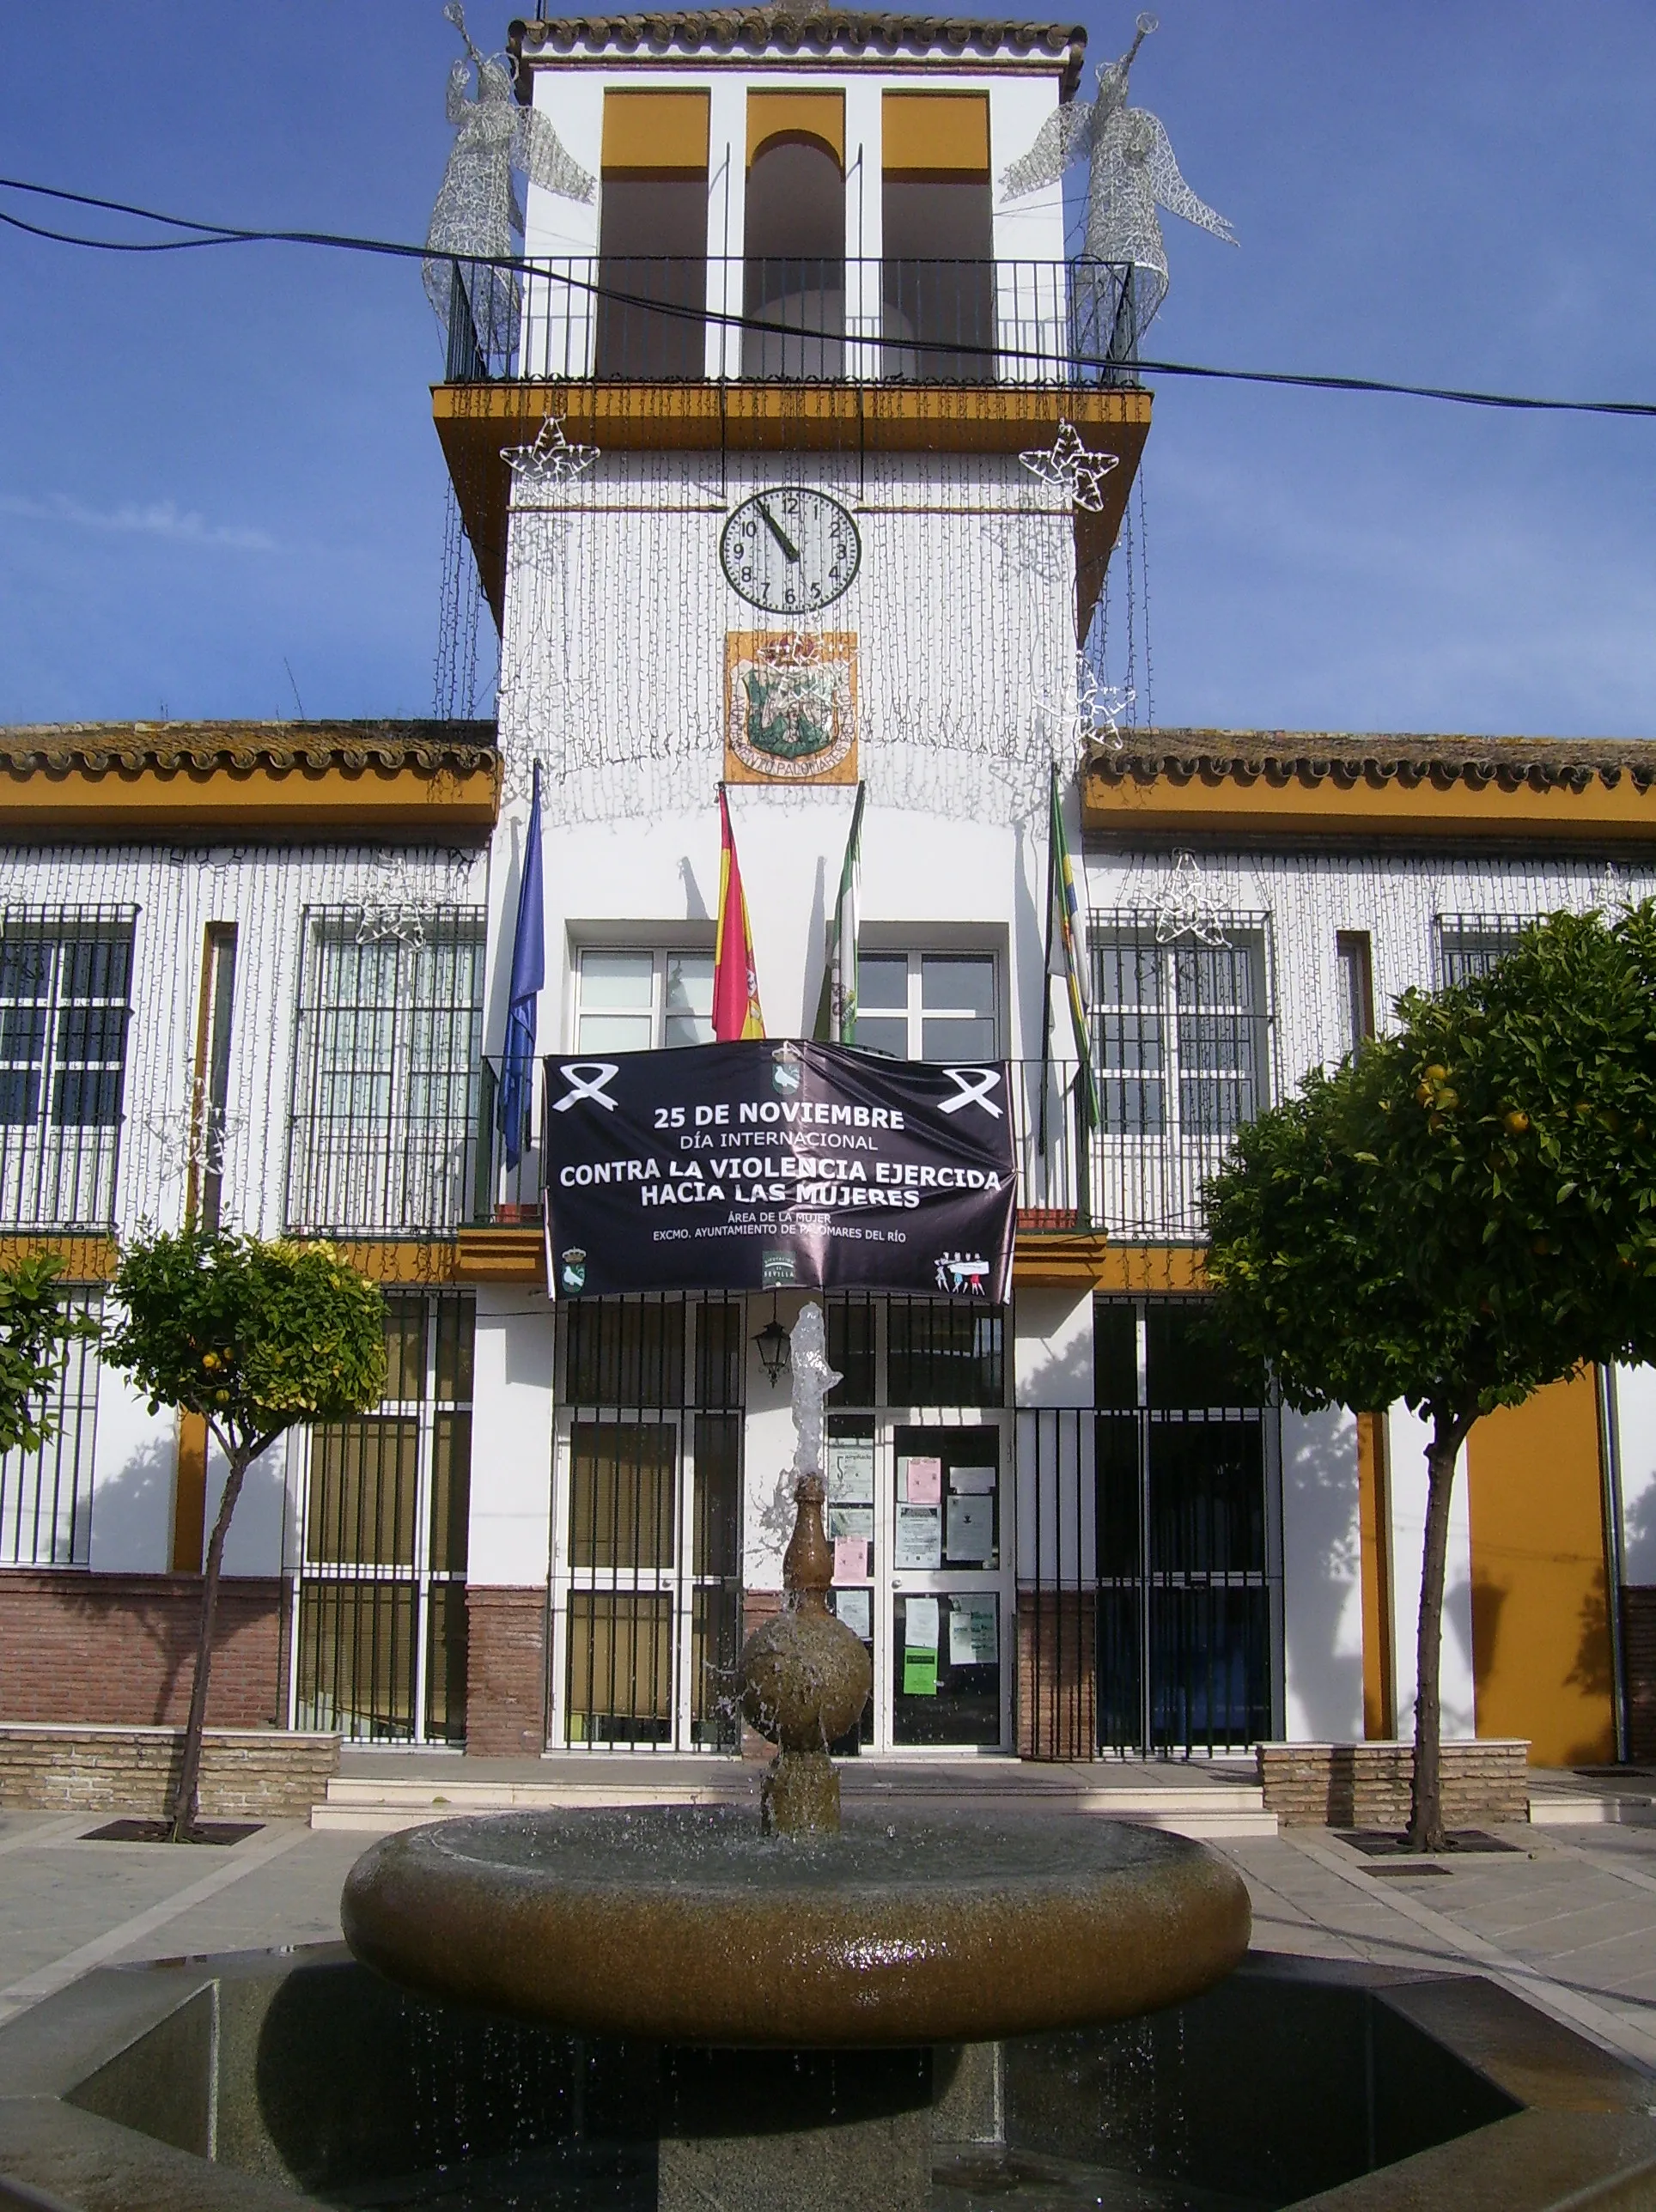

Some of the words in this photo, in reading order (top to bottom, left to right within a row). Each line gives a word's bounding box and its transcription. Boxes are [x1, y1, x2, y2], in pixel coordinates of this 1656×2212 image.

[783, 498, 798, 514] 12
[813, 504, 819, 520] 1
[741, 521, 757, 538] 10
[830, 522, 841, 538] 2
[734, 544, 745, 560] 9
[836, 544, 847, 560] 3
[741, 567, 752, 583] 8
[829, 566, 841, 581] 4
[761, 582, 770, 599] 7
[785, 588, 796, 605] 6
[811, 582, 822, 599] 5
[776, 742, 848, 775] PALOMARES
[654, 1107, 685, 1129] 25
[695, 1104, 729, 1126] DE
[740, 1102, 905, 1130] NOVIEMBRE
[680, 1131, 714, 1150] DÍA
[720, 1132, 879, 1151] INTERNACIONAL
[559, 1158, 661, 1187] CONTRA
[668, 1161, 703, 1180] LA
[709, 1157, 868, 1181] VIOLENCIA
[875, 1163, 1002, 1191] EJERCIDA
[641, 1182, 725, 1206] HACIA
[734, 1183, 786, 1203] LAS
[795, 1184, 920, 1208] MUJERES
[728, 1211, 756, 1224] ÁREA
[760, 1212, 776, 1222] DE
[778, 1212, 792, 1222] LA
[795, 1212, 831, 1224] MUJER
[653, 1229, 691, 1241] EXCMO.
[694, 1224, 777, 1238] AYUNTAMIENTO
[781, 1224, 796, 1235] DE
[865, 1229, 885, 1242] DEL
[887, 1229, 906, 1243] RÍO
